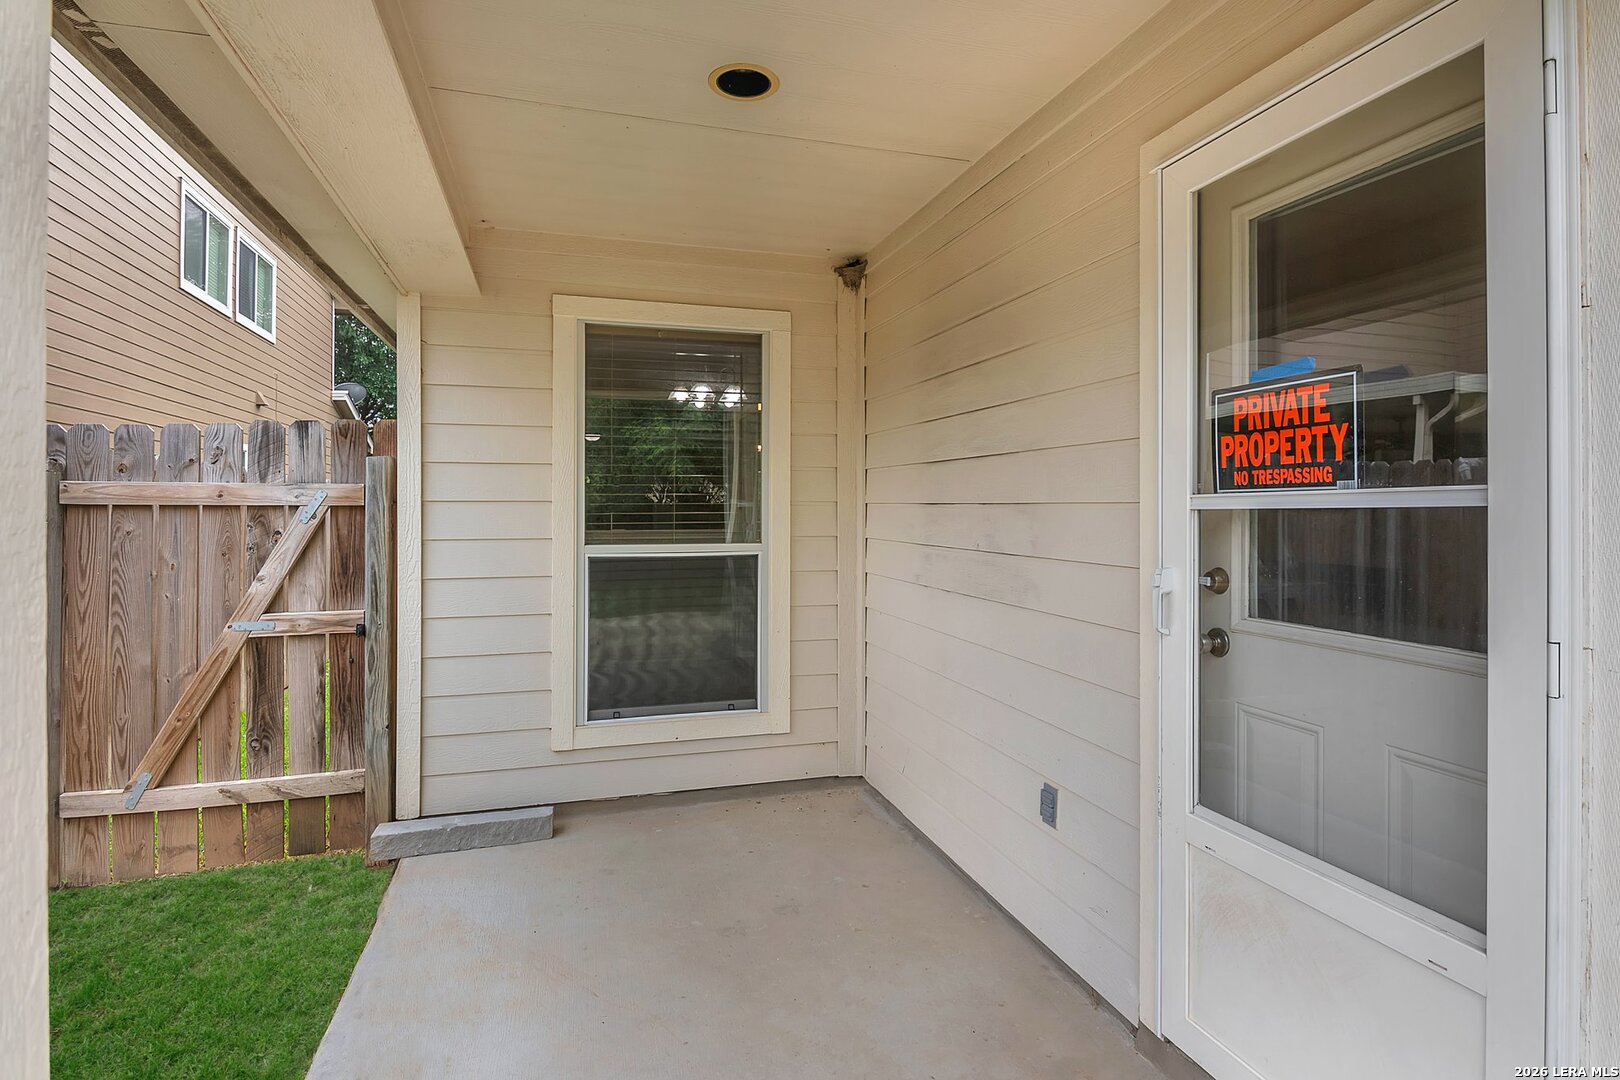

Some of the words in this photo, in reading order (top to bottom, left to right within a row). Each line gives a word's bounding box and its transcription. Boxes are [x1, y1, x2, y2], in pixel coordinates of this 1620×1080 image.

[1233, 383, 1331, 432] PRIVATE
[1220, 422, 1349, 469] PROPERTY
[1234, 471, 1249, 486] NO
[1252, 466, 1333, 485] TRESPASSING
